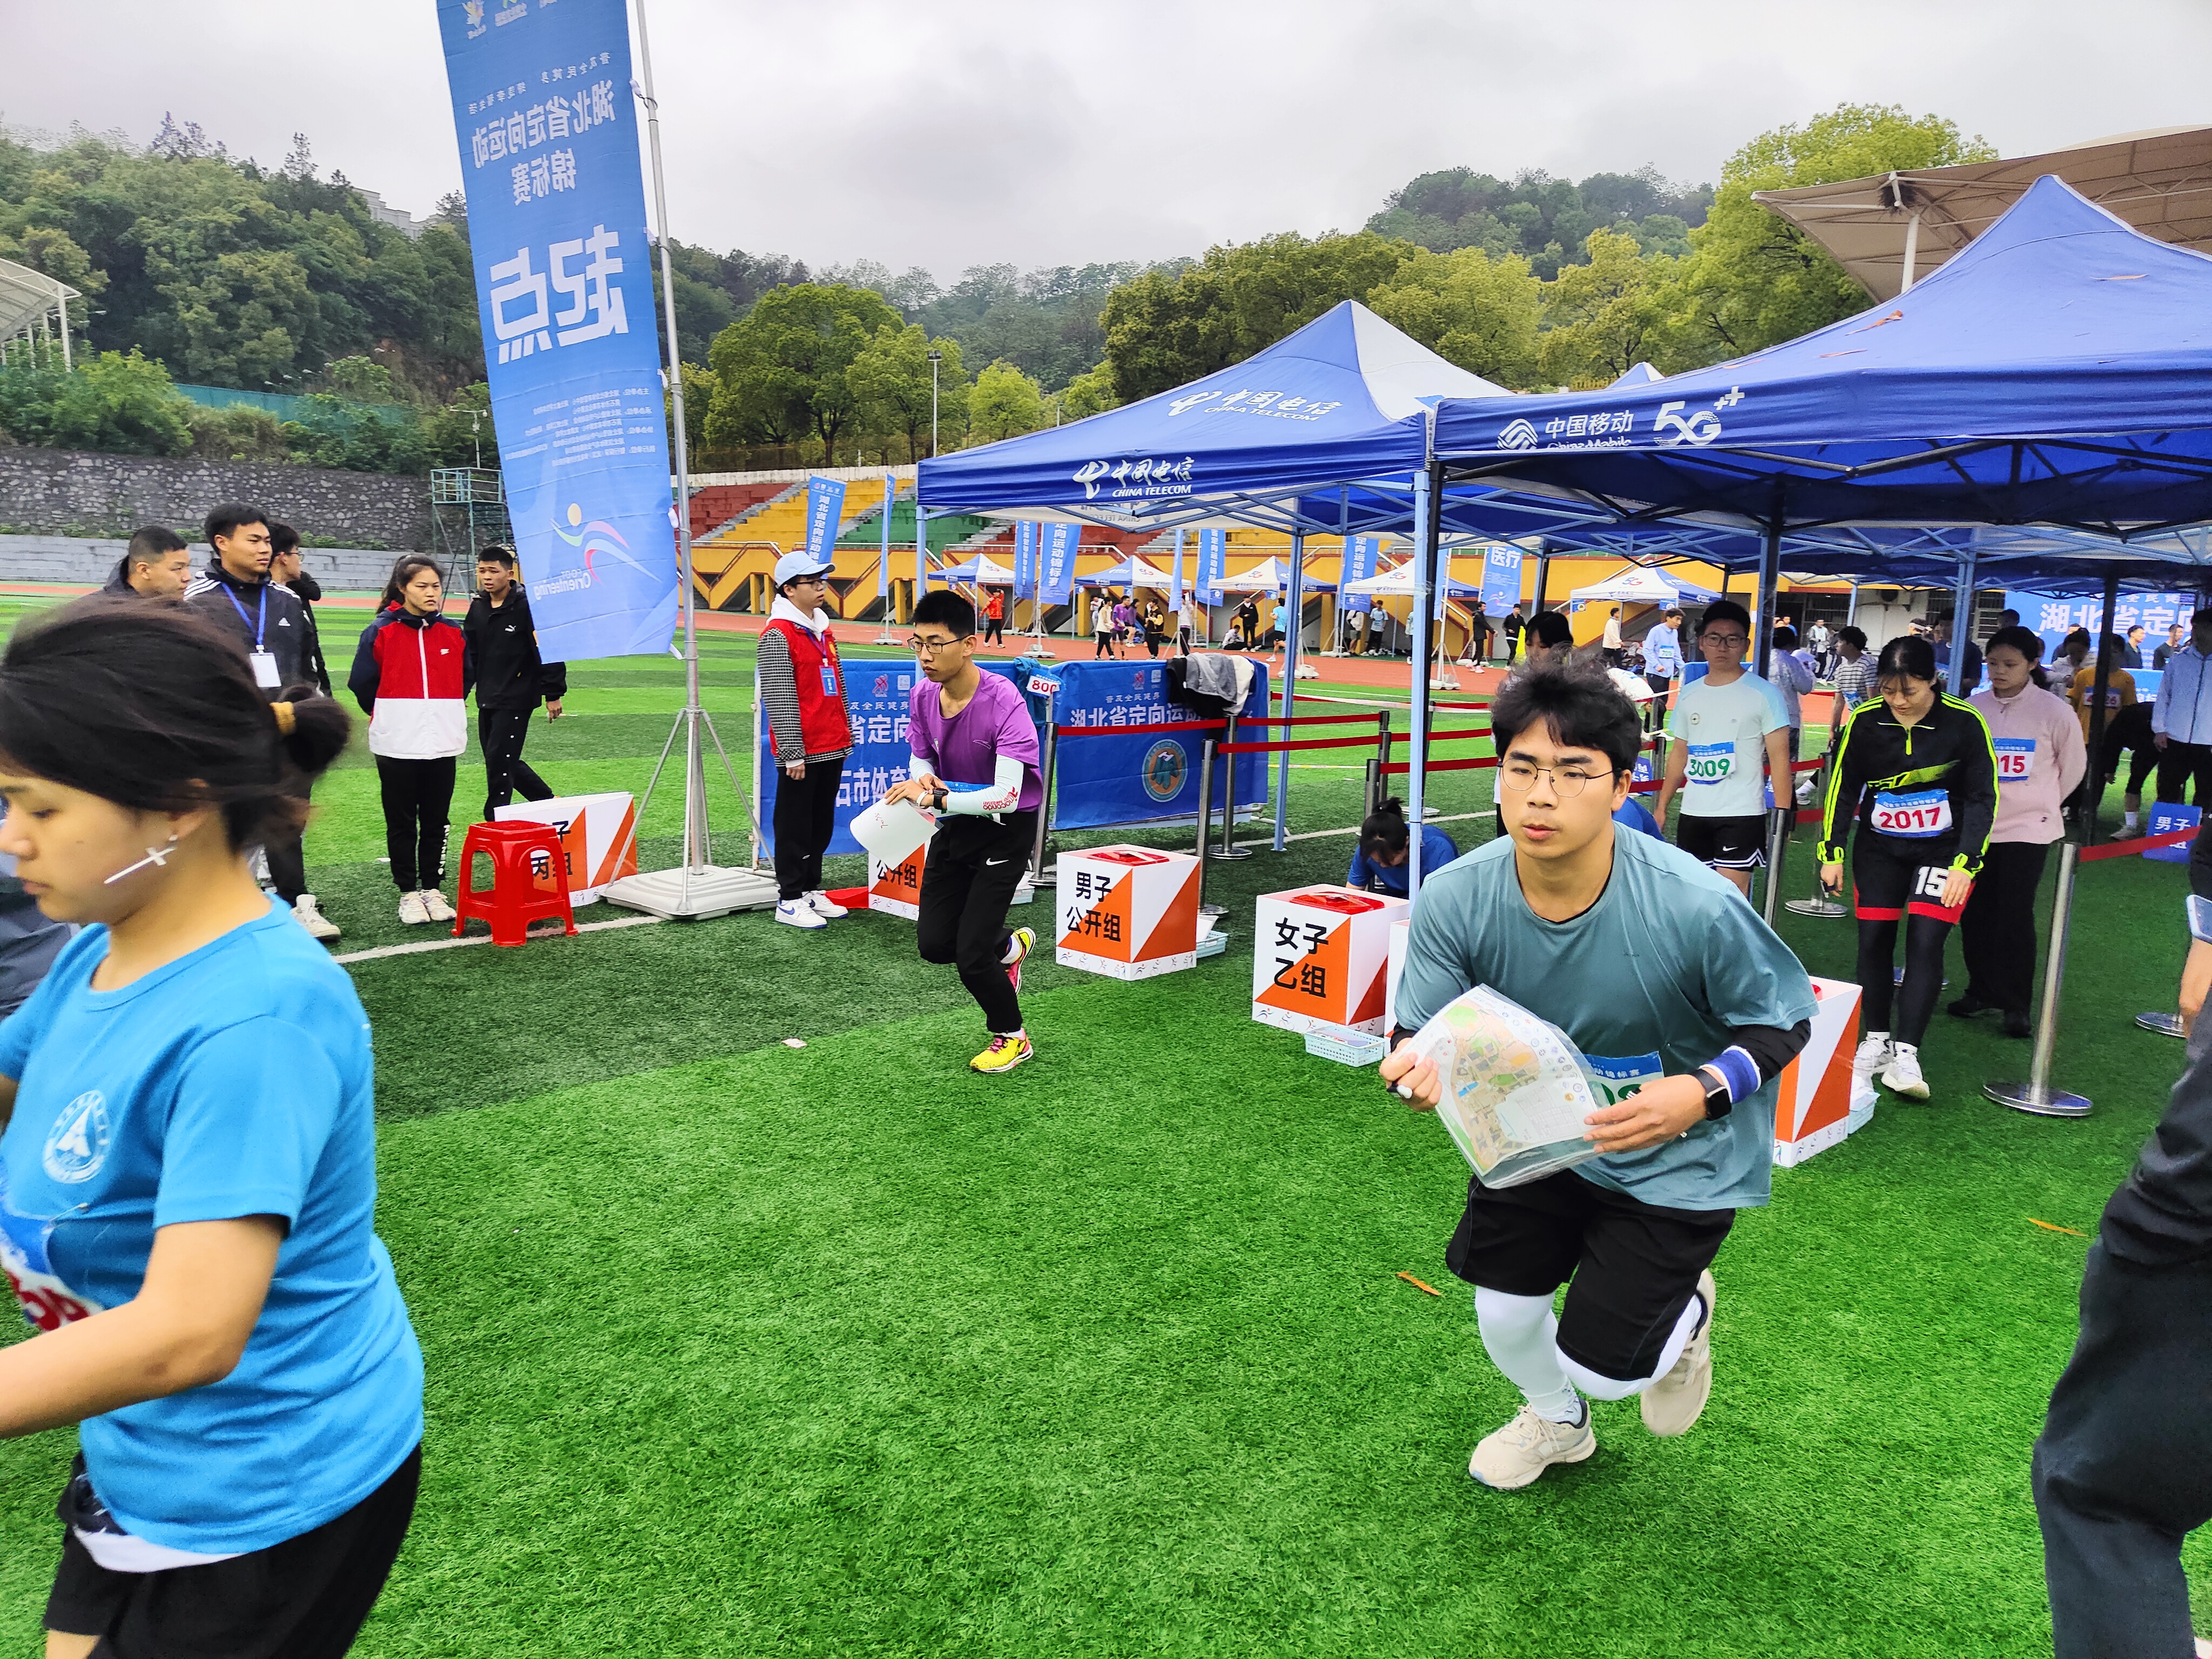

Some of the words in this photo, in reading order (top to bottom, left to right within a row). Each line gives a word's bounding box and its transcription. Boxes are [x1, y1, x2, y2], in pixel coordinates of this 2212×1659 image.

[1221, 388, 1343, 415] 中国电信
[1249, 408, 1319, 421] TELECOM
[1545, 409, 1635, 439] 中国移动
[1110, 456, 1195, 488] 中国电信
[1111, 487, 1144, 497] CHINA
[1145, 484, 1192, 496] TELECOM
[1491, 547, 1521, 569] 医疗
[1622, 577, 1643, 585] 5G
[1996, 755, 2025, 773] 15
[1879, 806, 1940, 829] 2017
[2154, 816, 2191, 831] 男子
[876, 860, 917, 888] 公开组
[1076, 871, 1112, 902] 男子
[1914, 866, 1950, 897] 15
[1067, 906, 1121, 942] 公开组
[1274, 917, 1329, 954] 女子
[1273, 957, 1327, 999] 乙组
